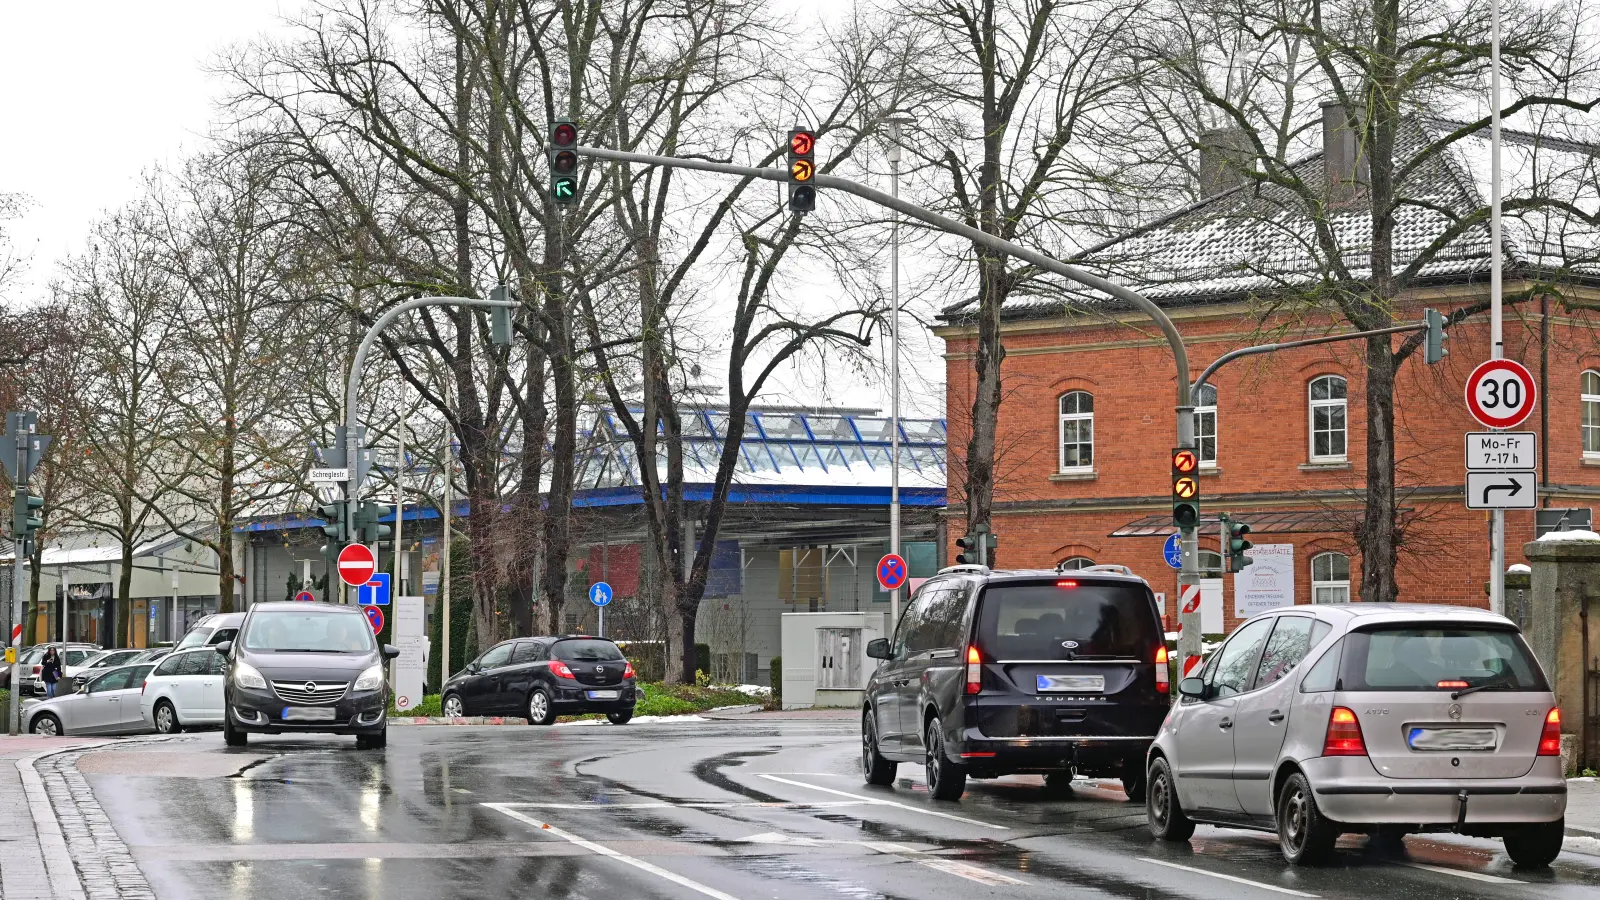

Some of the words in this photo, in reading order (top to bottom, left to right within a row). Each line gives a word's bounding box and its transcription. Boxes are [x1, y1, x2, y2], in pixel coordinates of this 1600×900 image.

[1482, 378, 1521, 409] 30
[1481, 438, 1521, 449] Mo-Fr
[1484, 453, 1509, 464] 7-17
[1513, 453, 1519, 464] h
[312, 471, 346, 479] Schreglestr.
